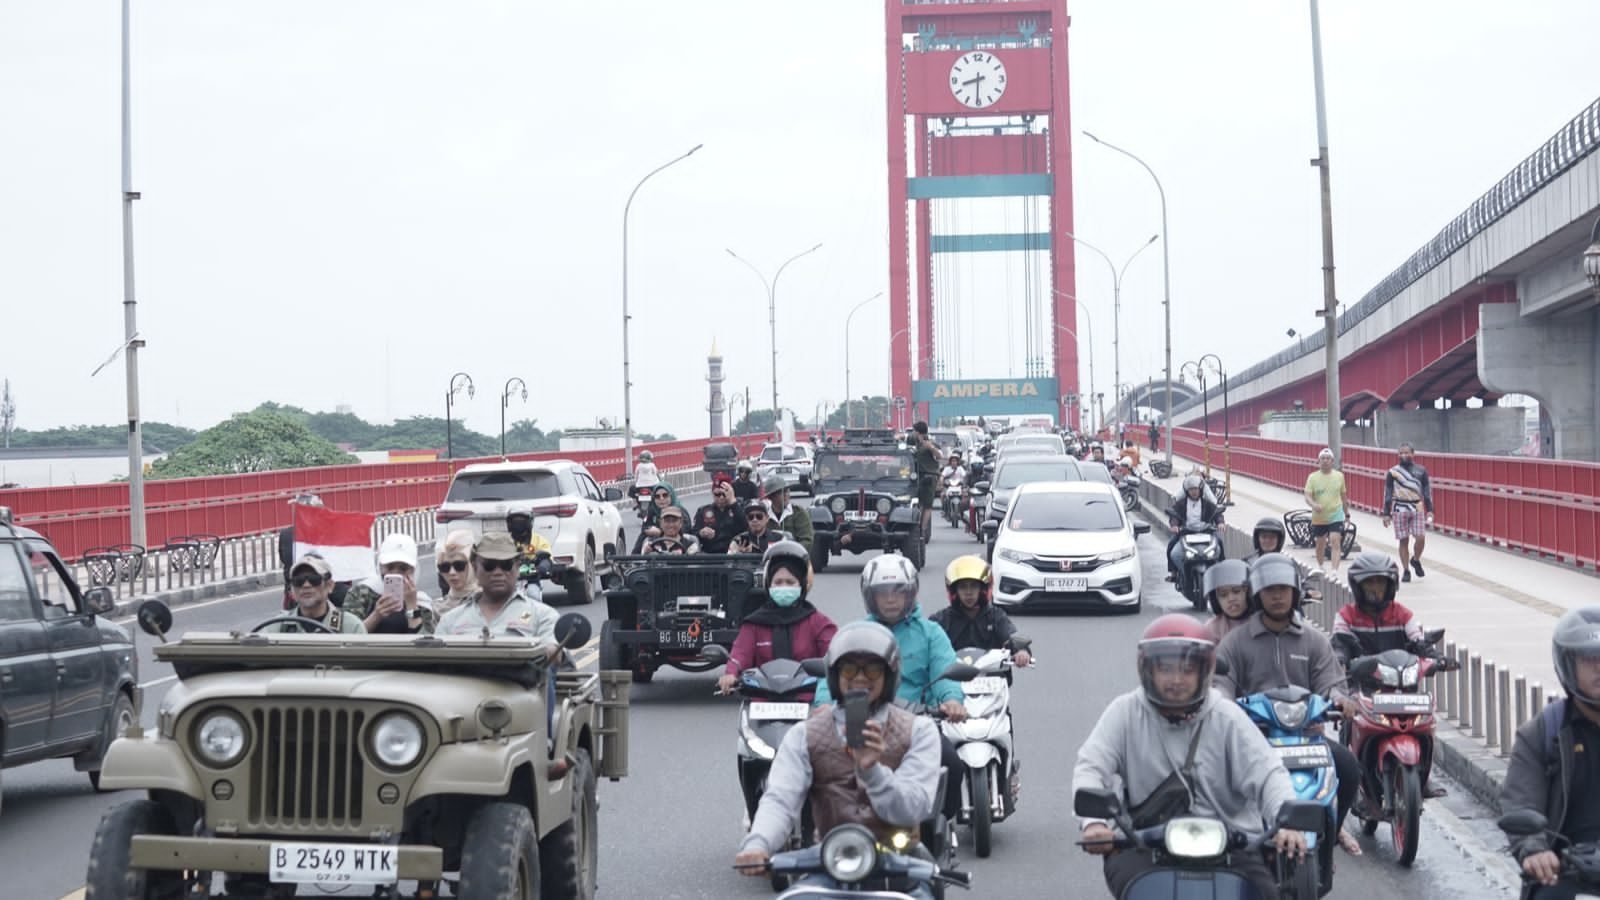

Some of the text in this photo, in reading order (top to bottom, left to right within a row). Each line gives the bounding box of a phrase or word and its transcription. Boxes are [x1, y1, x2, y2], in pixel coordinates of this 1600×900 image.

[972, 53, 983, 62] 12
[998, 74, 1005, 83] 3
[933, 382, 1039, 398] AMPERA
[659, 631, 671, 643] BG
[703, 631, 713, 642] EA
[276, 847, 391, 871] B 2549 WTK
